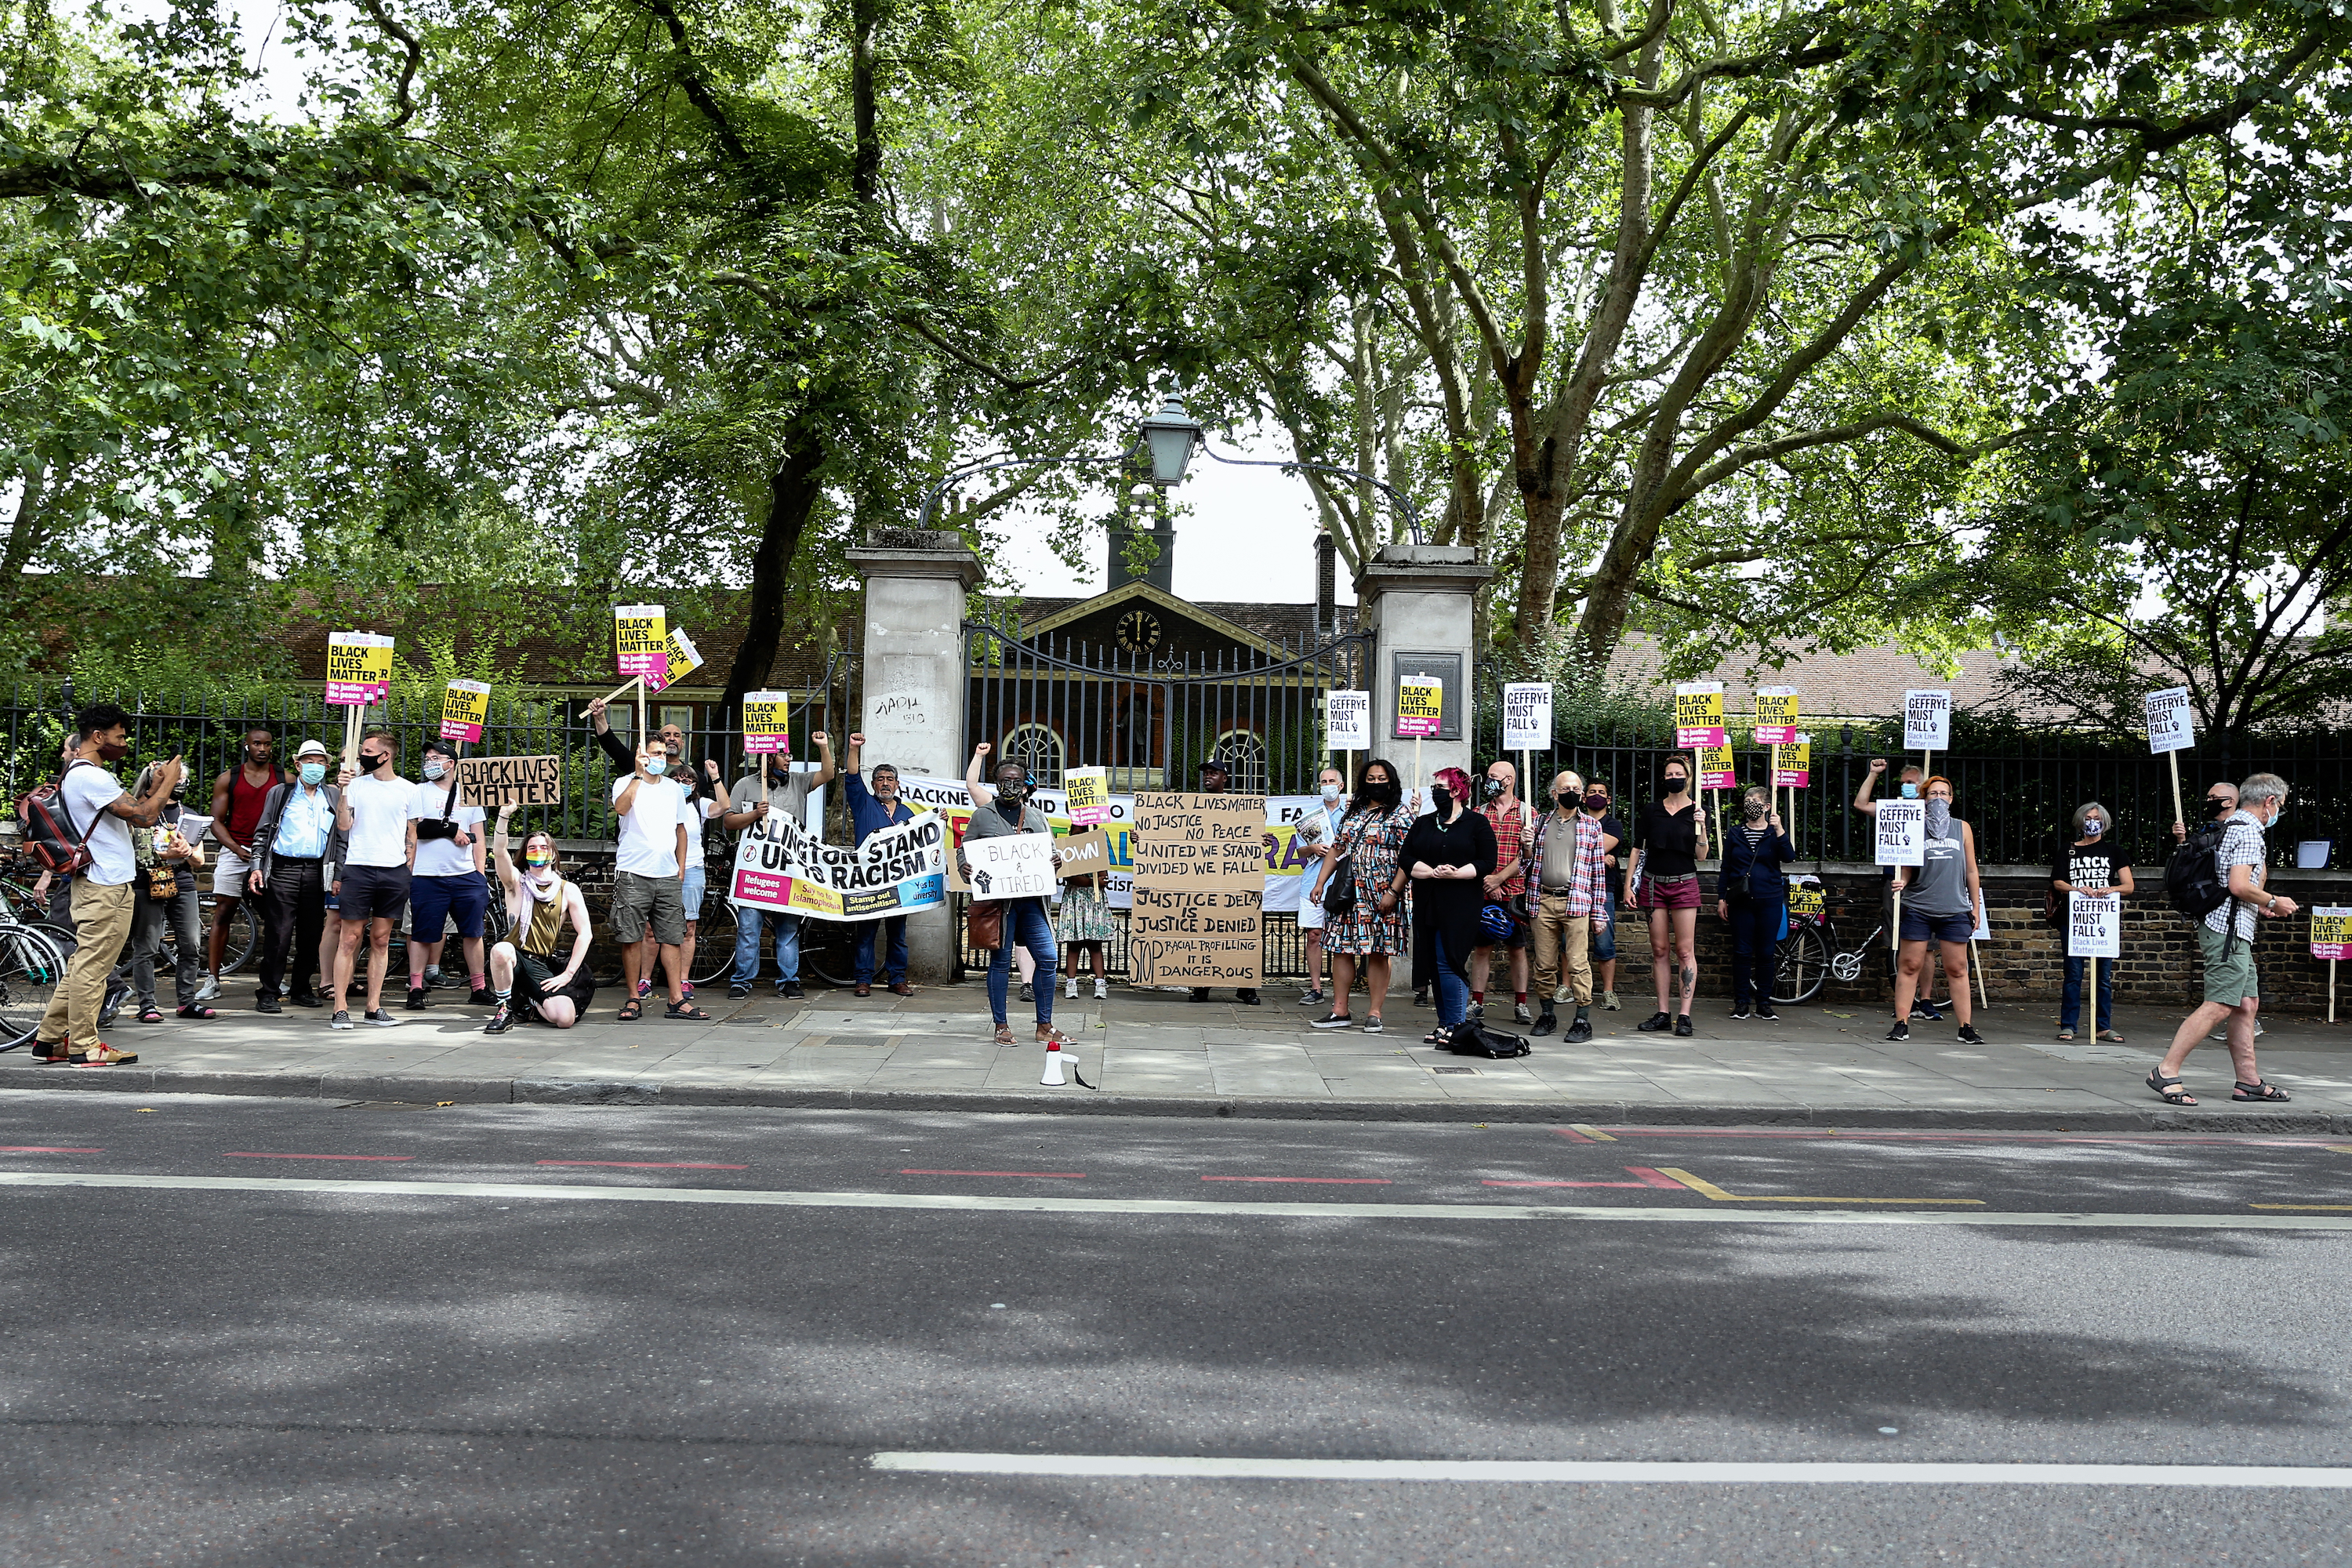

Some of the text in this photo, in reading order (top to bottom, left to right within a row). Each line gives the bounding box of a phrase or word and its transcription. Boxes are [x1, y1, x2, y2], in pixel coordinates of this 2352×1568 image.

[619, 619, 653, 630] BLACK
[619, 630, 648, 641] LIVES
[332, 646, 368, 658] BLACK
[619, 641, 663, 652] MATTER
[331, 658, 362, 669] LIVES
[330, 669, 376, 681] MATTER
[448, 689, 478, 702] BLACK
[1402, 687, 1432, 696] BLACK
[1401, 696, 1427, 706] LIVES
[1508, 692, 1548, 704] GEFFRYE
[1679, 695, 1712, 706] BLACK
[1759, 696, 1789, 706] BLACK
[446, 699, 471, 710] LIVES
[746, 703, 777, 713] BLACK
[1330, 699, 1367, 710] GEFFRYE
[1909, 699, 1947, 709] GEFFRYE
[2148, 695, 2186, 713] GEFFRYE
[445, 709, 482, 723] MATTER
[1330, 710, 1354, 720] MUST
[1401, 706, 1439, 716] MATTER
[1508, 705, 1534, 717] MUST
[1679, 706, 1707, 716] LIVES
[1759, 706, 1784, 715] LIVES
[1908, 710, 1934, 720] MUST
[746, 713, 772, 722] LIVES
[1679, 715, 1721, 726] MATTER
[1758, 715, 1795, 724] MATTER
[2149, 710, 2172, 724] MUST
[450, 721, 470, 730] justice
[746, 724, 786, 732] MATTER
[1330, 721, 1350, 731] FALL
[1508, 718, 1528, 729] FALL
[1908, 721, 1928, 731] FALL
[2150, 722, 2170, 735] FALL
[1689, 728, 1711, 737] justice
[2151, 735, 2166, 743] Black
[2153, 742, 2171, 751] Matter
[460, 757, 559, 784] BLACK LIVES
[1068, 777, 1097, 789] BLACK
[463, 782, 559, 805] MATTER
[899, 786, 969, 806] HACKNE
[1069, 787, 1094, 797] LIVES
[1070, 796, 1106, 807] MATTER
[1135, 794, 1185, 810] BLACK
[1879, 809, 1921, 821] GEFFRYE
[1135, 814, 1202, 831] NO JUSTICE
[1879, 822, 1906, 833] MUST
[1185, 823, 1251, 840] NO PEACE
[746, 817, 859, 865] ISLINGTON
[867, 822, 941, 863] STAND
[1879, 834, 1900, 845] FALL
[988, 843, 1044, 862] BLACK
[1136, 842, 1261, 859] UNITED WE STAND
[761, 844, 794, 872] UP
[832, 851, 927, 890] RACISM
[1016, 862, 1022, 873] &
[1136, 861, 1259, 876] DIVIDED WE FALL
[2074, 868, 2105, 879] LIVES
[744, 874, 780, 888] Refugees
[997, 874, 1044, 894] TIRED
[2071, 878, 2110, 888] MATTER
[743, 887, 778, 898] welcome
[802, 884, 815, 895] Say
[913, 888, 938, 900] diversity
[793, 892, 841, 910] Islamophobia
[849, 891, 891, 906] Stamp out
[1136, 890, 1262, 910] JUSTICE DELAY
[846, 897, 897, 913] antisemitism
[2073, 901, 2116, 912] GEFFRYE
[1181, 907, 1197, 918] IS
[2073, 913, 2101, 924] MUST
[2314, 916, 2346, 926] BLACK
[1135, 915, 1256, 934] JUSTICE DENIED
[2073, 926, 2096, 937] FALL
[2314, 934, 2352, 942] MATTER
[1165, 941, 1256, 954] RACIAL PROFILLING
[1131, 938, 1163, 984] STOP
[1188, 955, 1212, 964] IT IS
[1160, 966, 1254, 979] DANGEROUS
